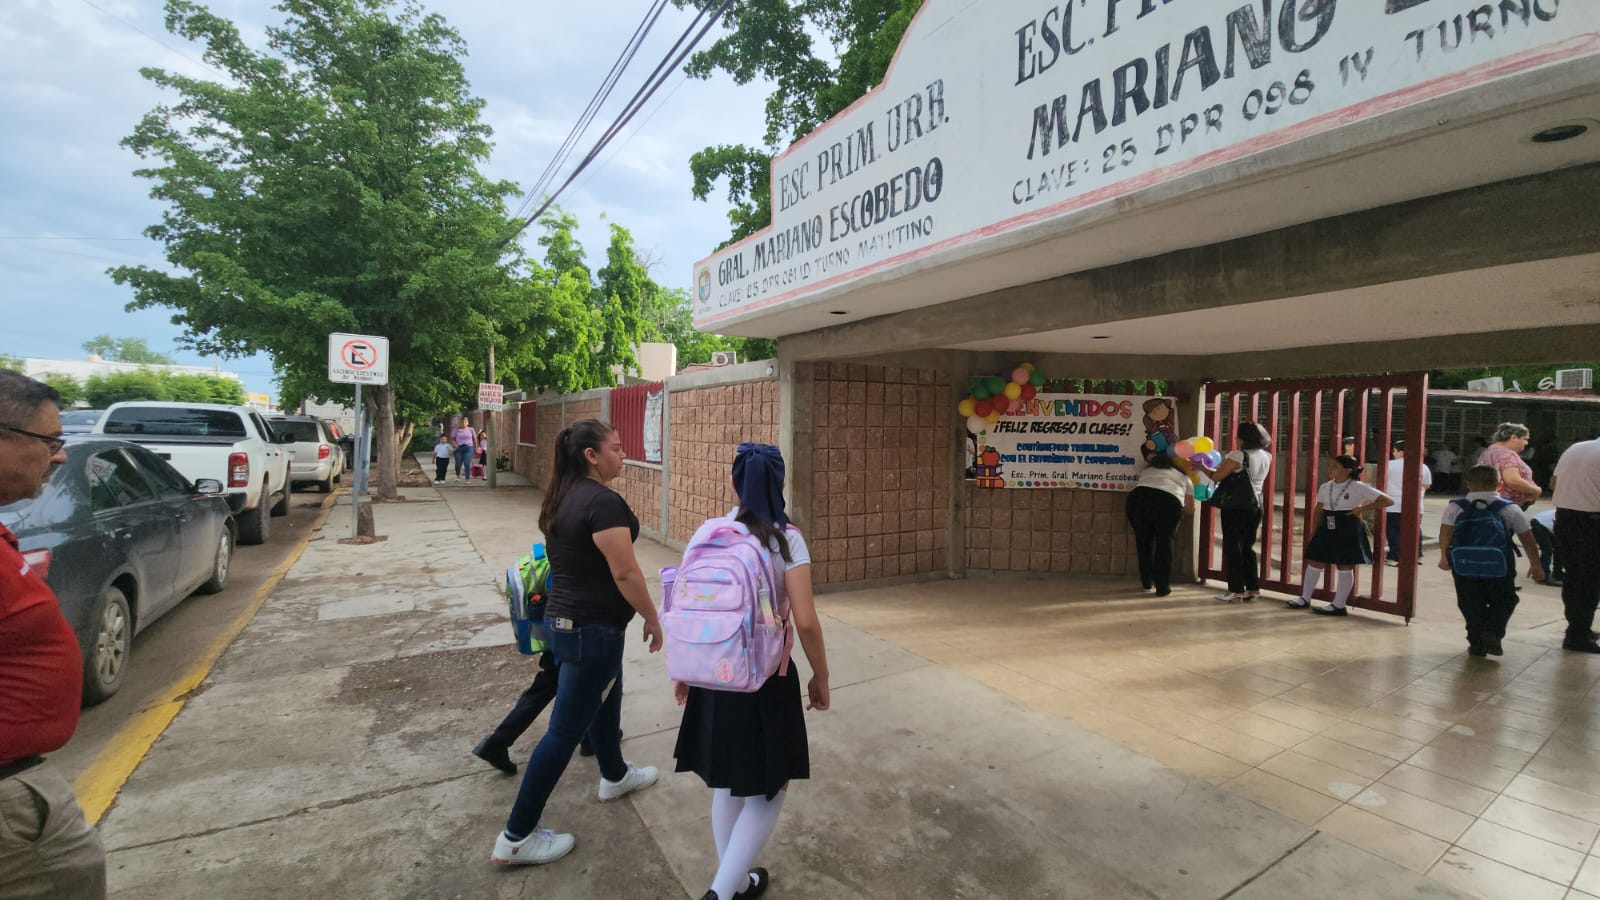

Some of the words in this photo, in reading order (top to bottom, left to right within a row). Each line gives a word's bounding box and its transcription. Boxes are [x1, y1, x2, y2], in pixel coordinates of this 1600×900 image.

[1012, 159, 1089, 205] CLAVE:
[1102, 137, 1137, 174] 25
[1154, 103, 1224, 156] DPR
[1242, 69, 1315, 121] 098
[1404, 0, 1560, 63] TURNO
[1026, 0, 1337, 160] MARIANO
[886, 78, 950, 153] URB.
[718, 252, 750, 287] GRAL.
[752, 214, 823, 273] MARIANO
[829, 156, 944, 243] ESCOBEDO
[857, 214, 934, 260] MATUTINO
[1000, 399, 1133, 419] ENVENIDOS
[1030, 421, 1078, 435] REGRESO
[1078, 422, 1087, 435] A
[1089, 423, 1134, 437] CLASES!
[1011, 470, 1026, 479] Esc.
[1029, 471, 1049, 479] Prim.
[1072, 471, 1103, 481] Mariano
